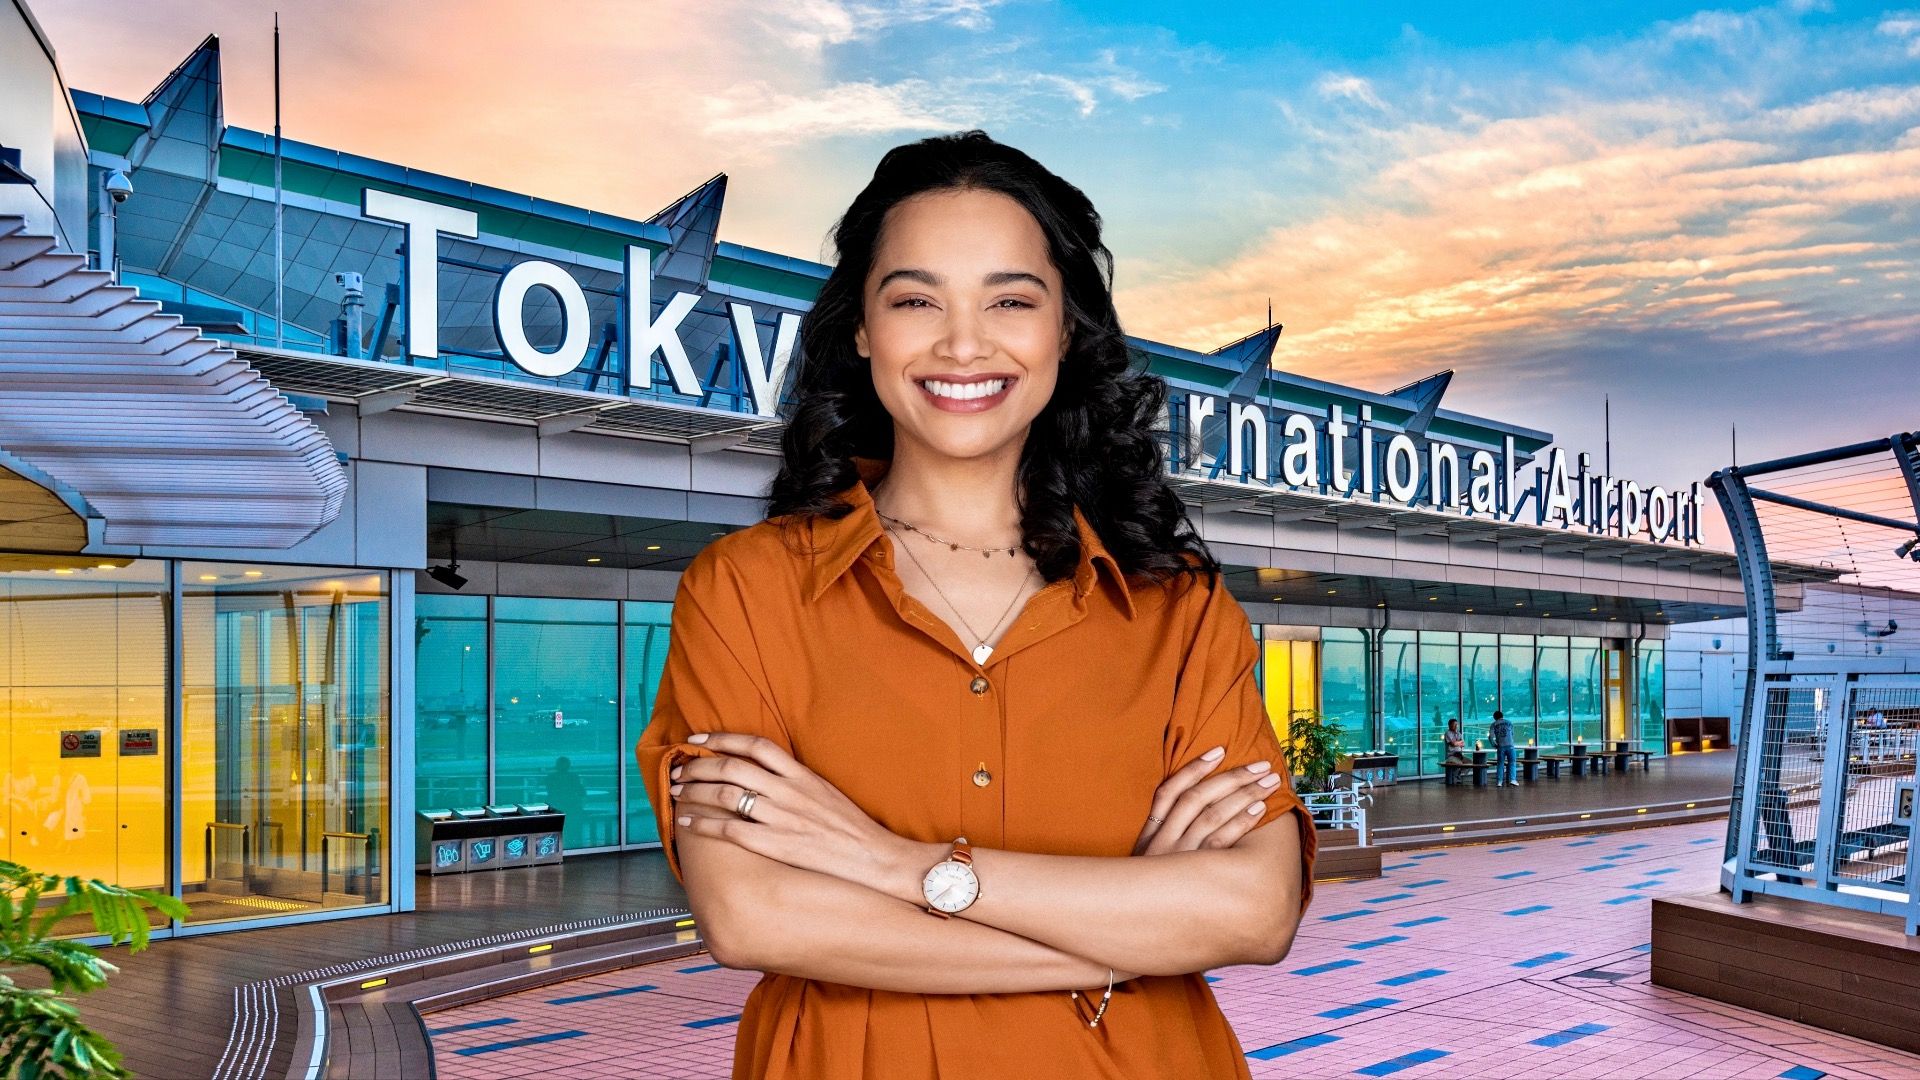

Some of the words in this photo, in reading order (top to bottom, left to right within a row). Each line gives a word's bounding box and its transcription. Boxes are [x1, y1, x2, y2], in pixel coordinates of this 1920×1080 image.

[362, 187, 802, 417] Toky
[1185, 393, 1515, 514] rnational
[1543, 447, 1706, 545] Airport
